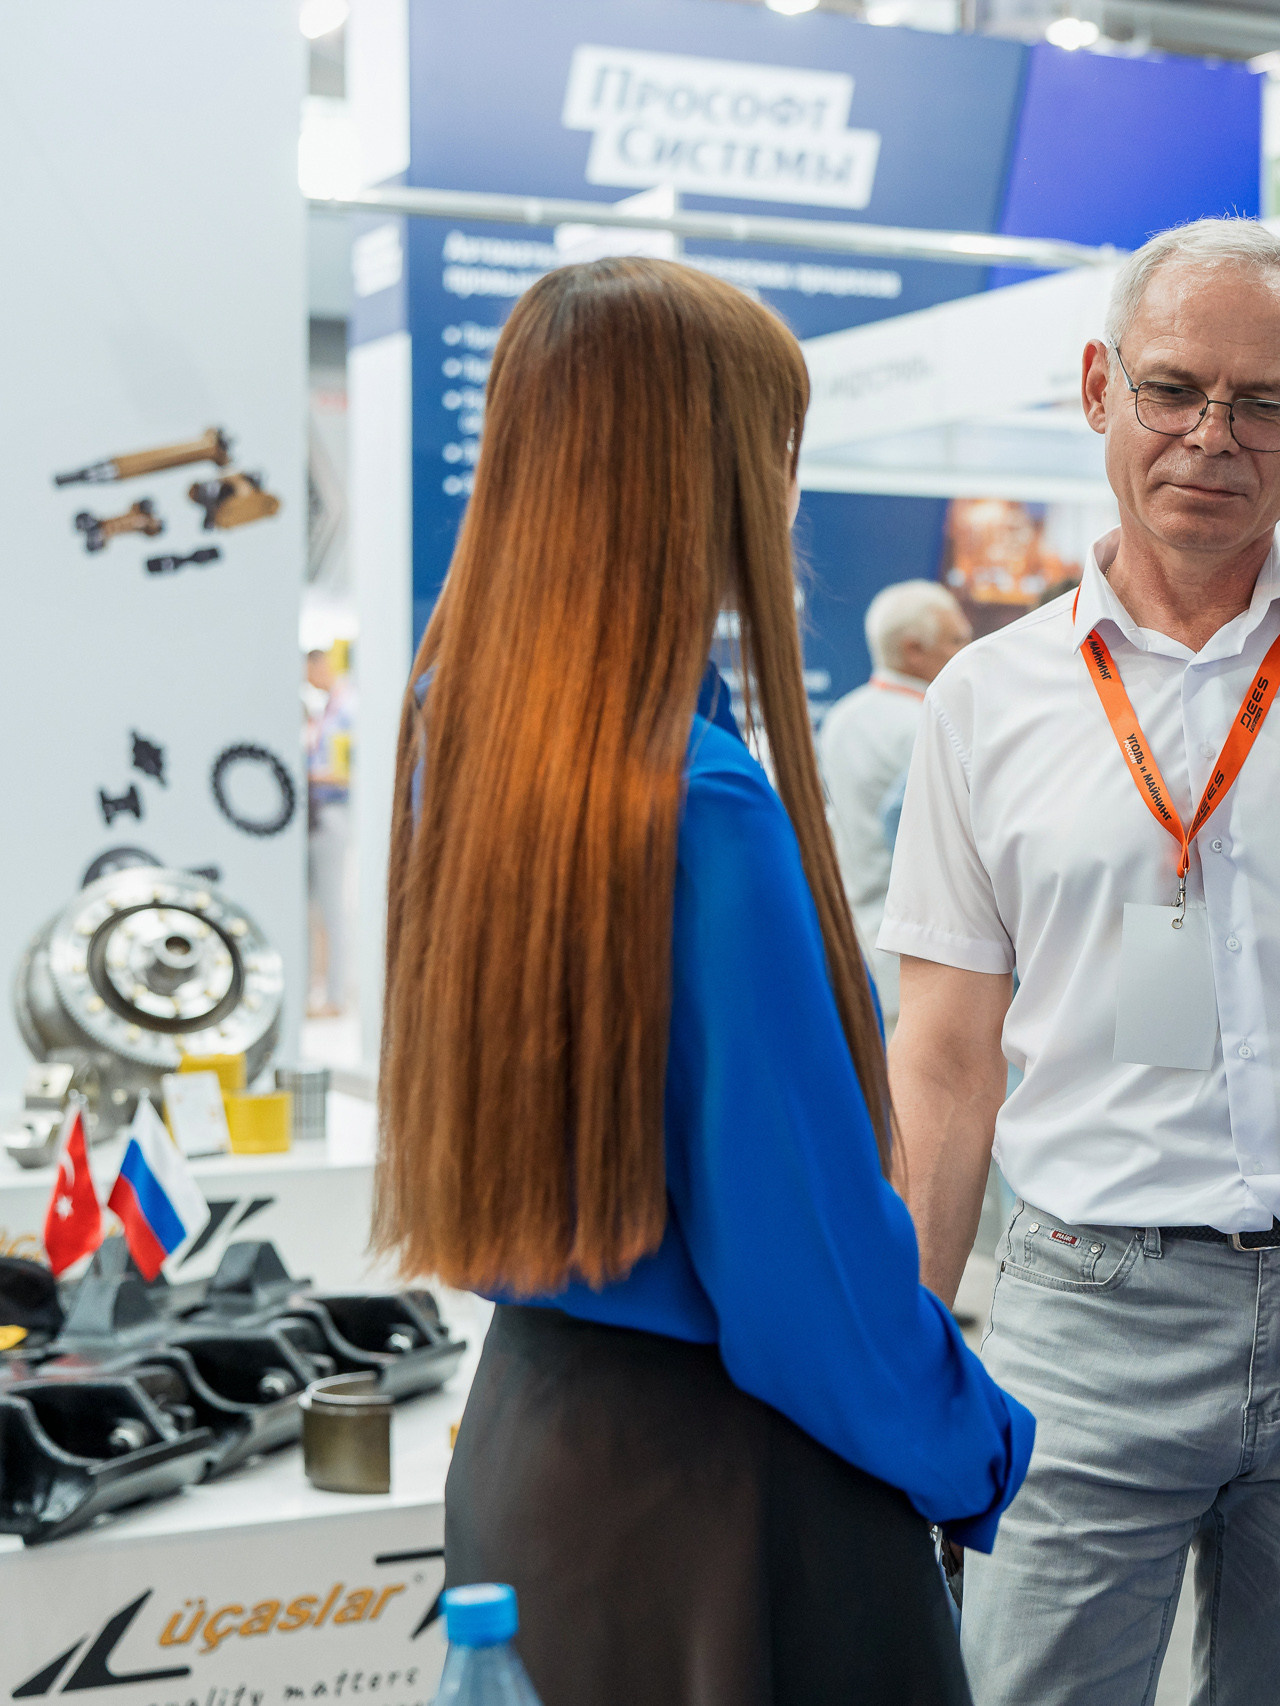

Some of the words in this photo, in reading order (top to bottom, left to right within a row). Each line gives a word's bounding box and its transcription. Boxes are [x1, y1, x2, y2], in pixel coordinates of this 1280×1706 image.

[1088, 641, 1113, 680] МАЙНИНГ
[1122, 740, 1138, 765] РОССИИ
[1126, 733, 1145, 765] УГОЛЬ
[1143, 773, 1173, 821] МАЙНИНГ
[157, 1580, 408, 1655] üçaslar
[283, 1666, 421, 1701] matters
